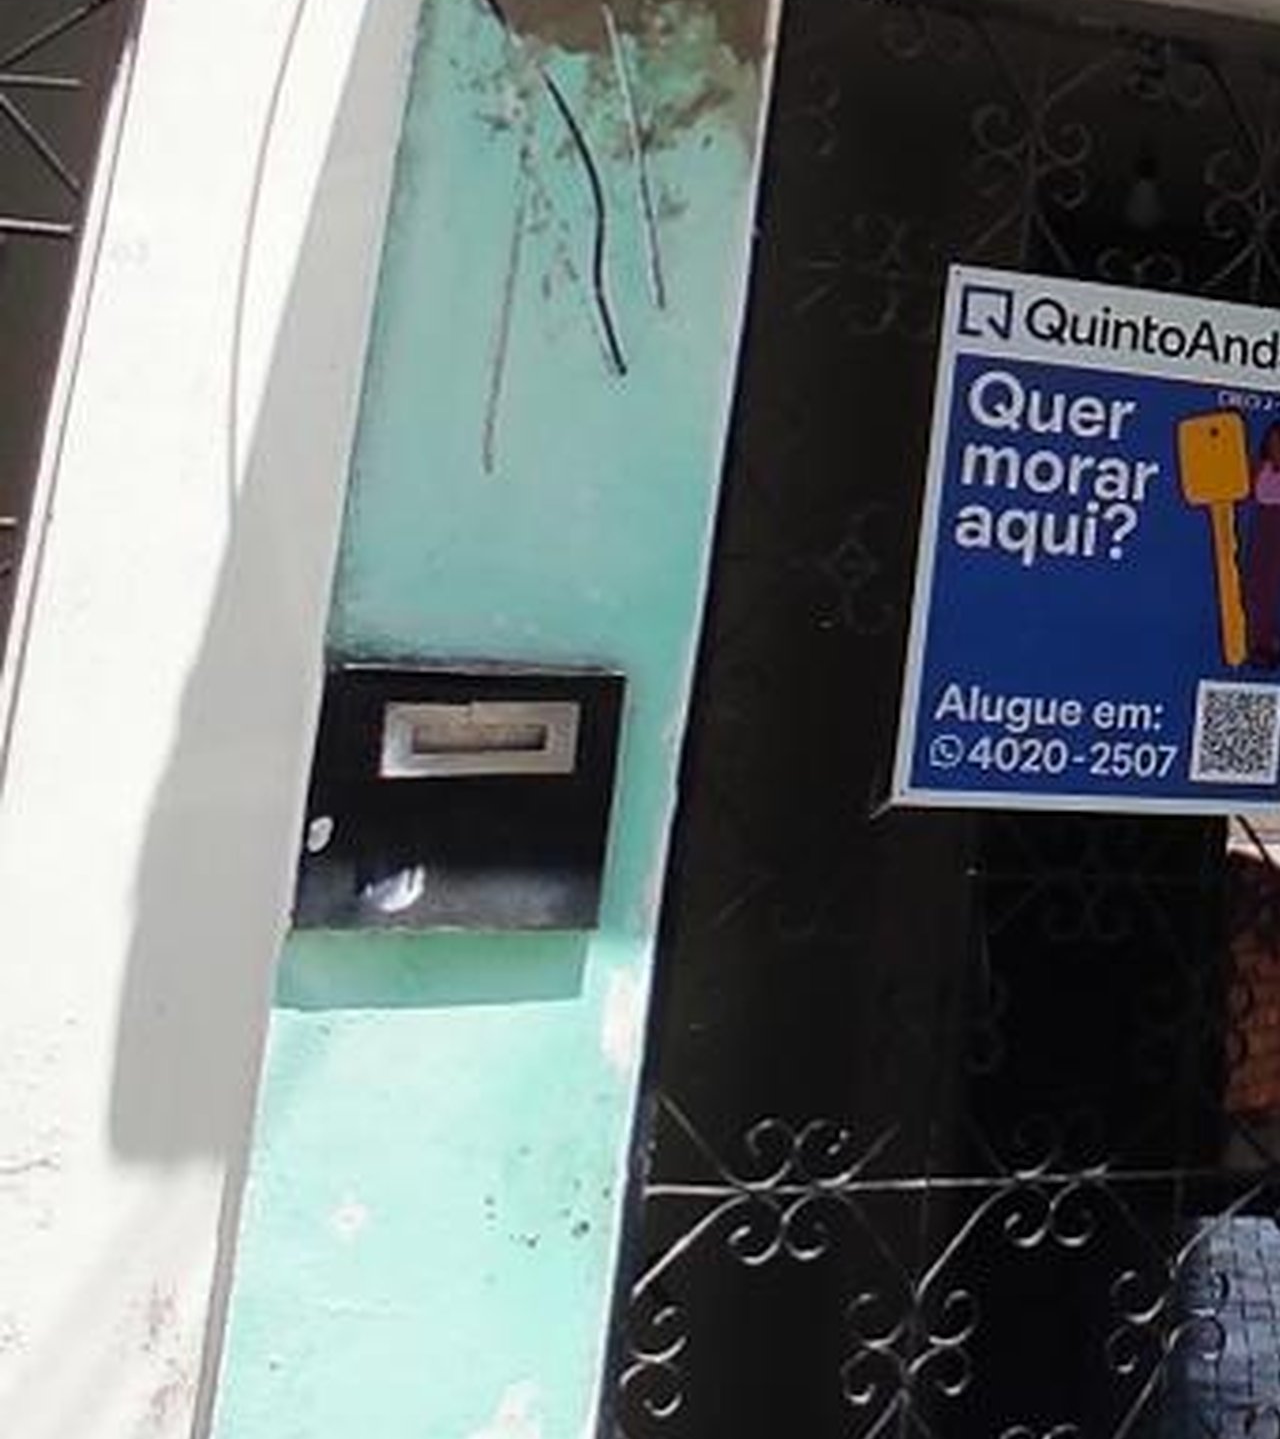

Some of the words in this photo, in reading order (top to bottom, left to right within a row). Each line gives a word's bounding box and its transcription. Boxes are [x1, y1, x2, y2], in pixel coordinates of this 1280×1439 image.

[968, 371, 1137, 440] Quer
[961, 442, 1160, 501] morar
[954, 501, 1138, 567] aqui?
[934, 683, 1082, 733] Alugue
[1093, 700, 1164, 731] em:
